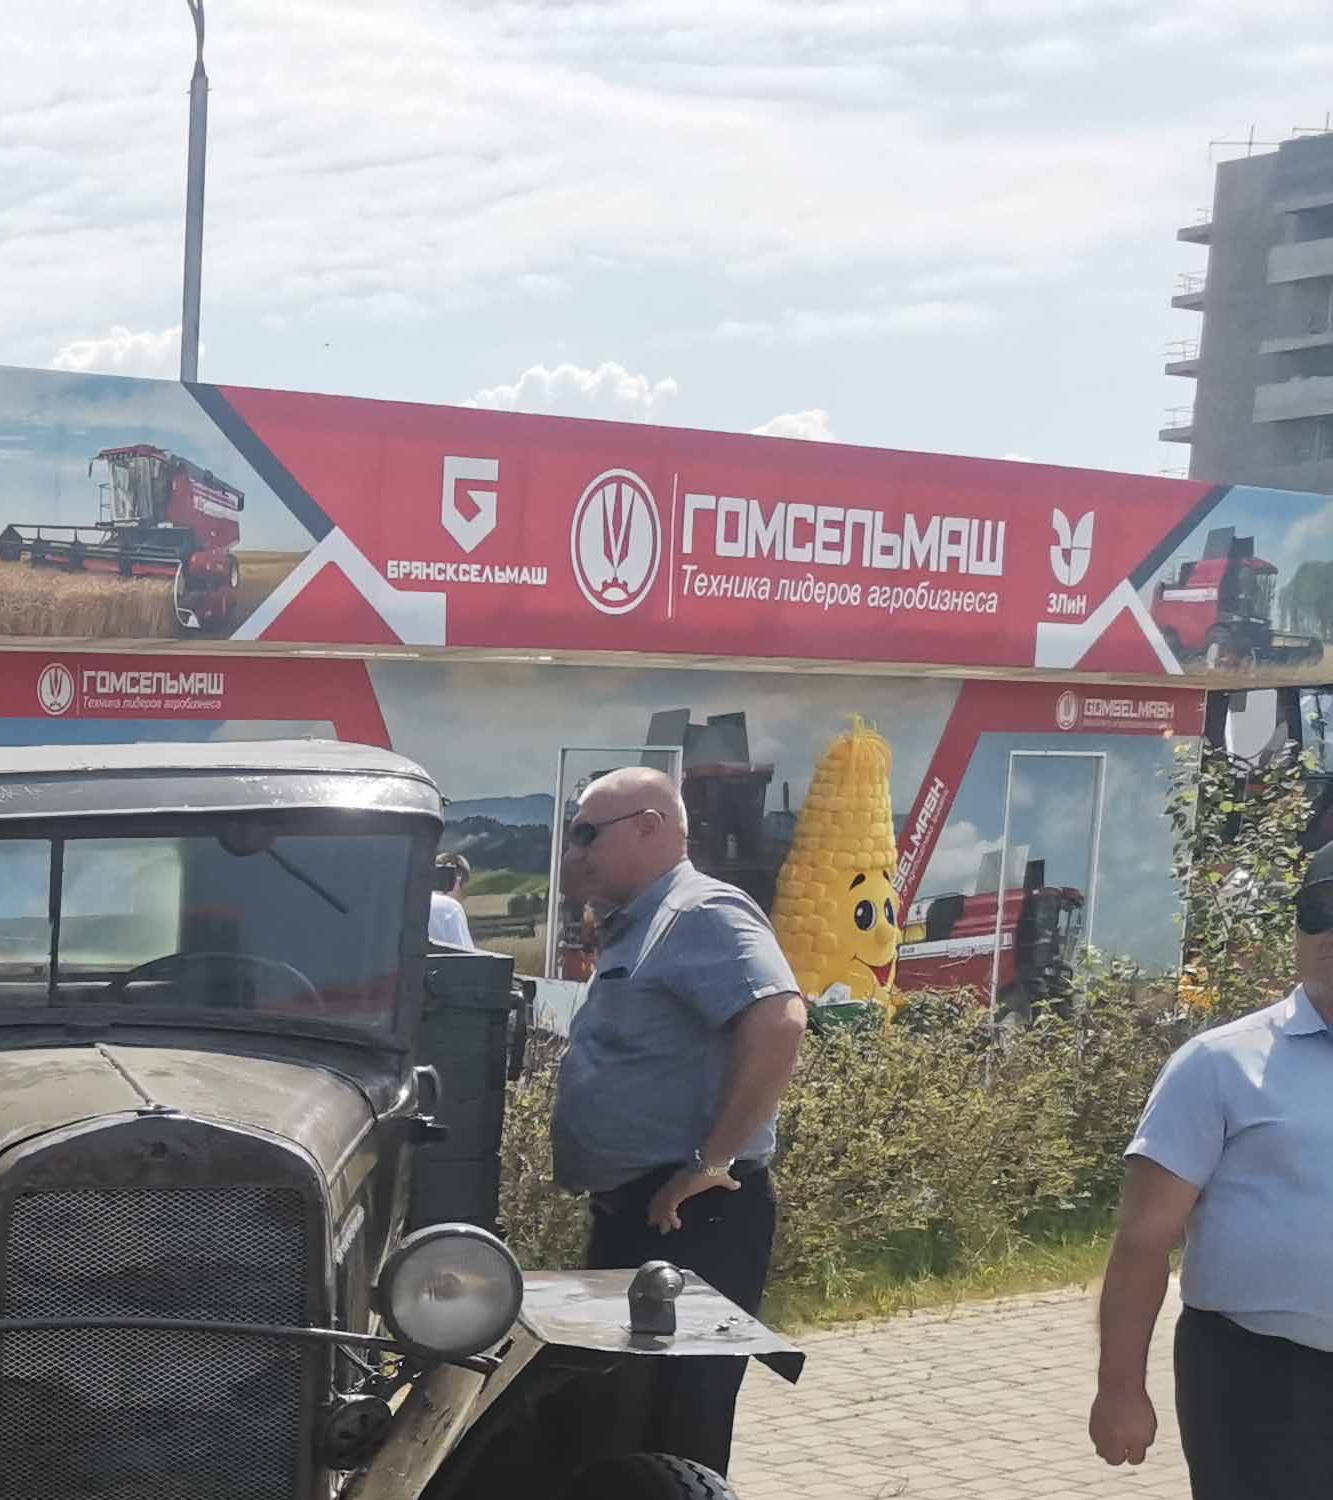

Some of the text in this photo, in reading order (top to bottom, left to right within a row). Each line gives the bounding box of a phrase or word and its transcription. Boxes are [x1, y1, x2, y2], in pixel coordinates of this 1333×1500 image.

[682, 493, 1006, 576] ГОМСЕЛЬМАШ
[387, 559, 548, 585] БРЯНСКСЕЛЬМАШ
[681, 564, 999, 615] Техника лидеров агробизнеса
[82, 670, 225, 695] ГОМСЕЛЬМАШ
